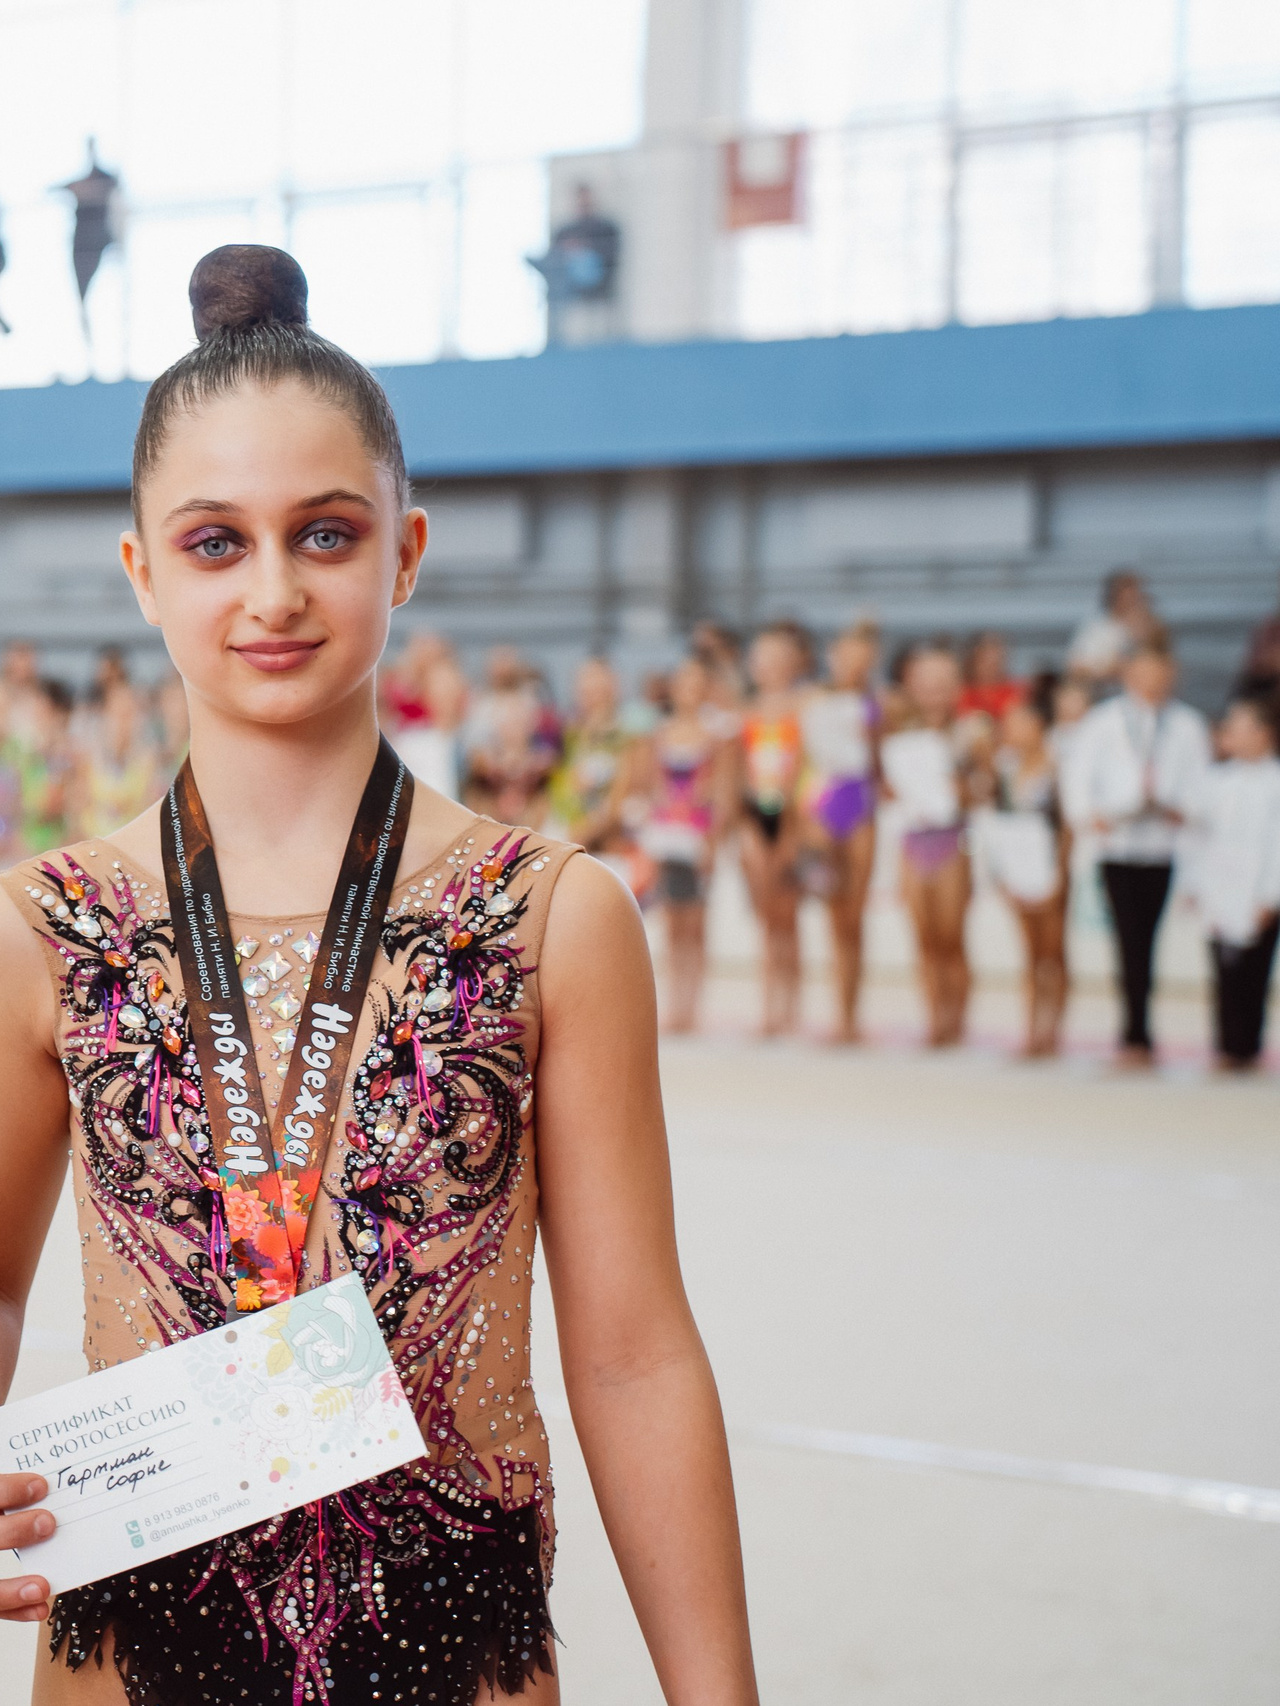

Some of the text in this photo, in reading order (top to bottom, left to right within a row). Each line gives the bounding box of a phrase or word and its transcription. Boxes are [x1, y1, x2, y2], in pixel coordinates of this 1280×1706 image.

[171, 817, 195, 898] художественной
[384, 817, 394, 831] по
[185, 899, 195, 912] по
[360, 832, 391, 920] художественной
[188, 913, 213, 1001] Соревнования
[201, 893, 231, 998] памяти Н. И. Бибко
[323, 883, 358, 989] памяти Н. И. Бибко
[341, 921, 368, 993] гимнастике
[208, 1012, 270, 1176] Надежды
[282, 1002, 354, 1167] Надежды
[9, 1394, 134, 1450] СЕРТИФИКАТ
[16, 1399, 187, 1471] НА ФОТОСЕССИЮ
[144, 1492, 221, 1528] 8 913 983 0876
[149, 1498, 251, 1543] @annushka_lysenko
